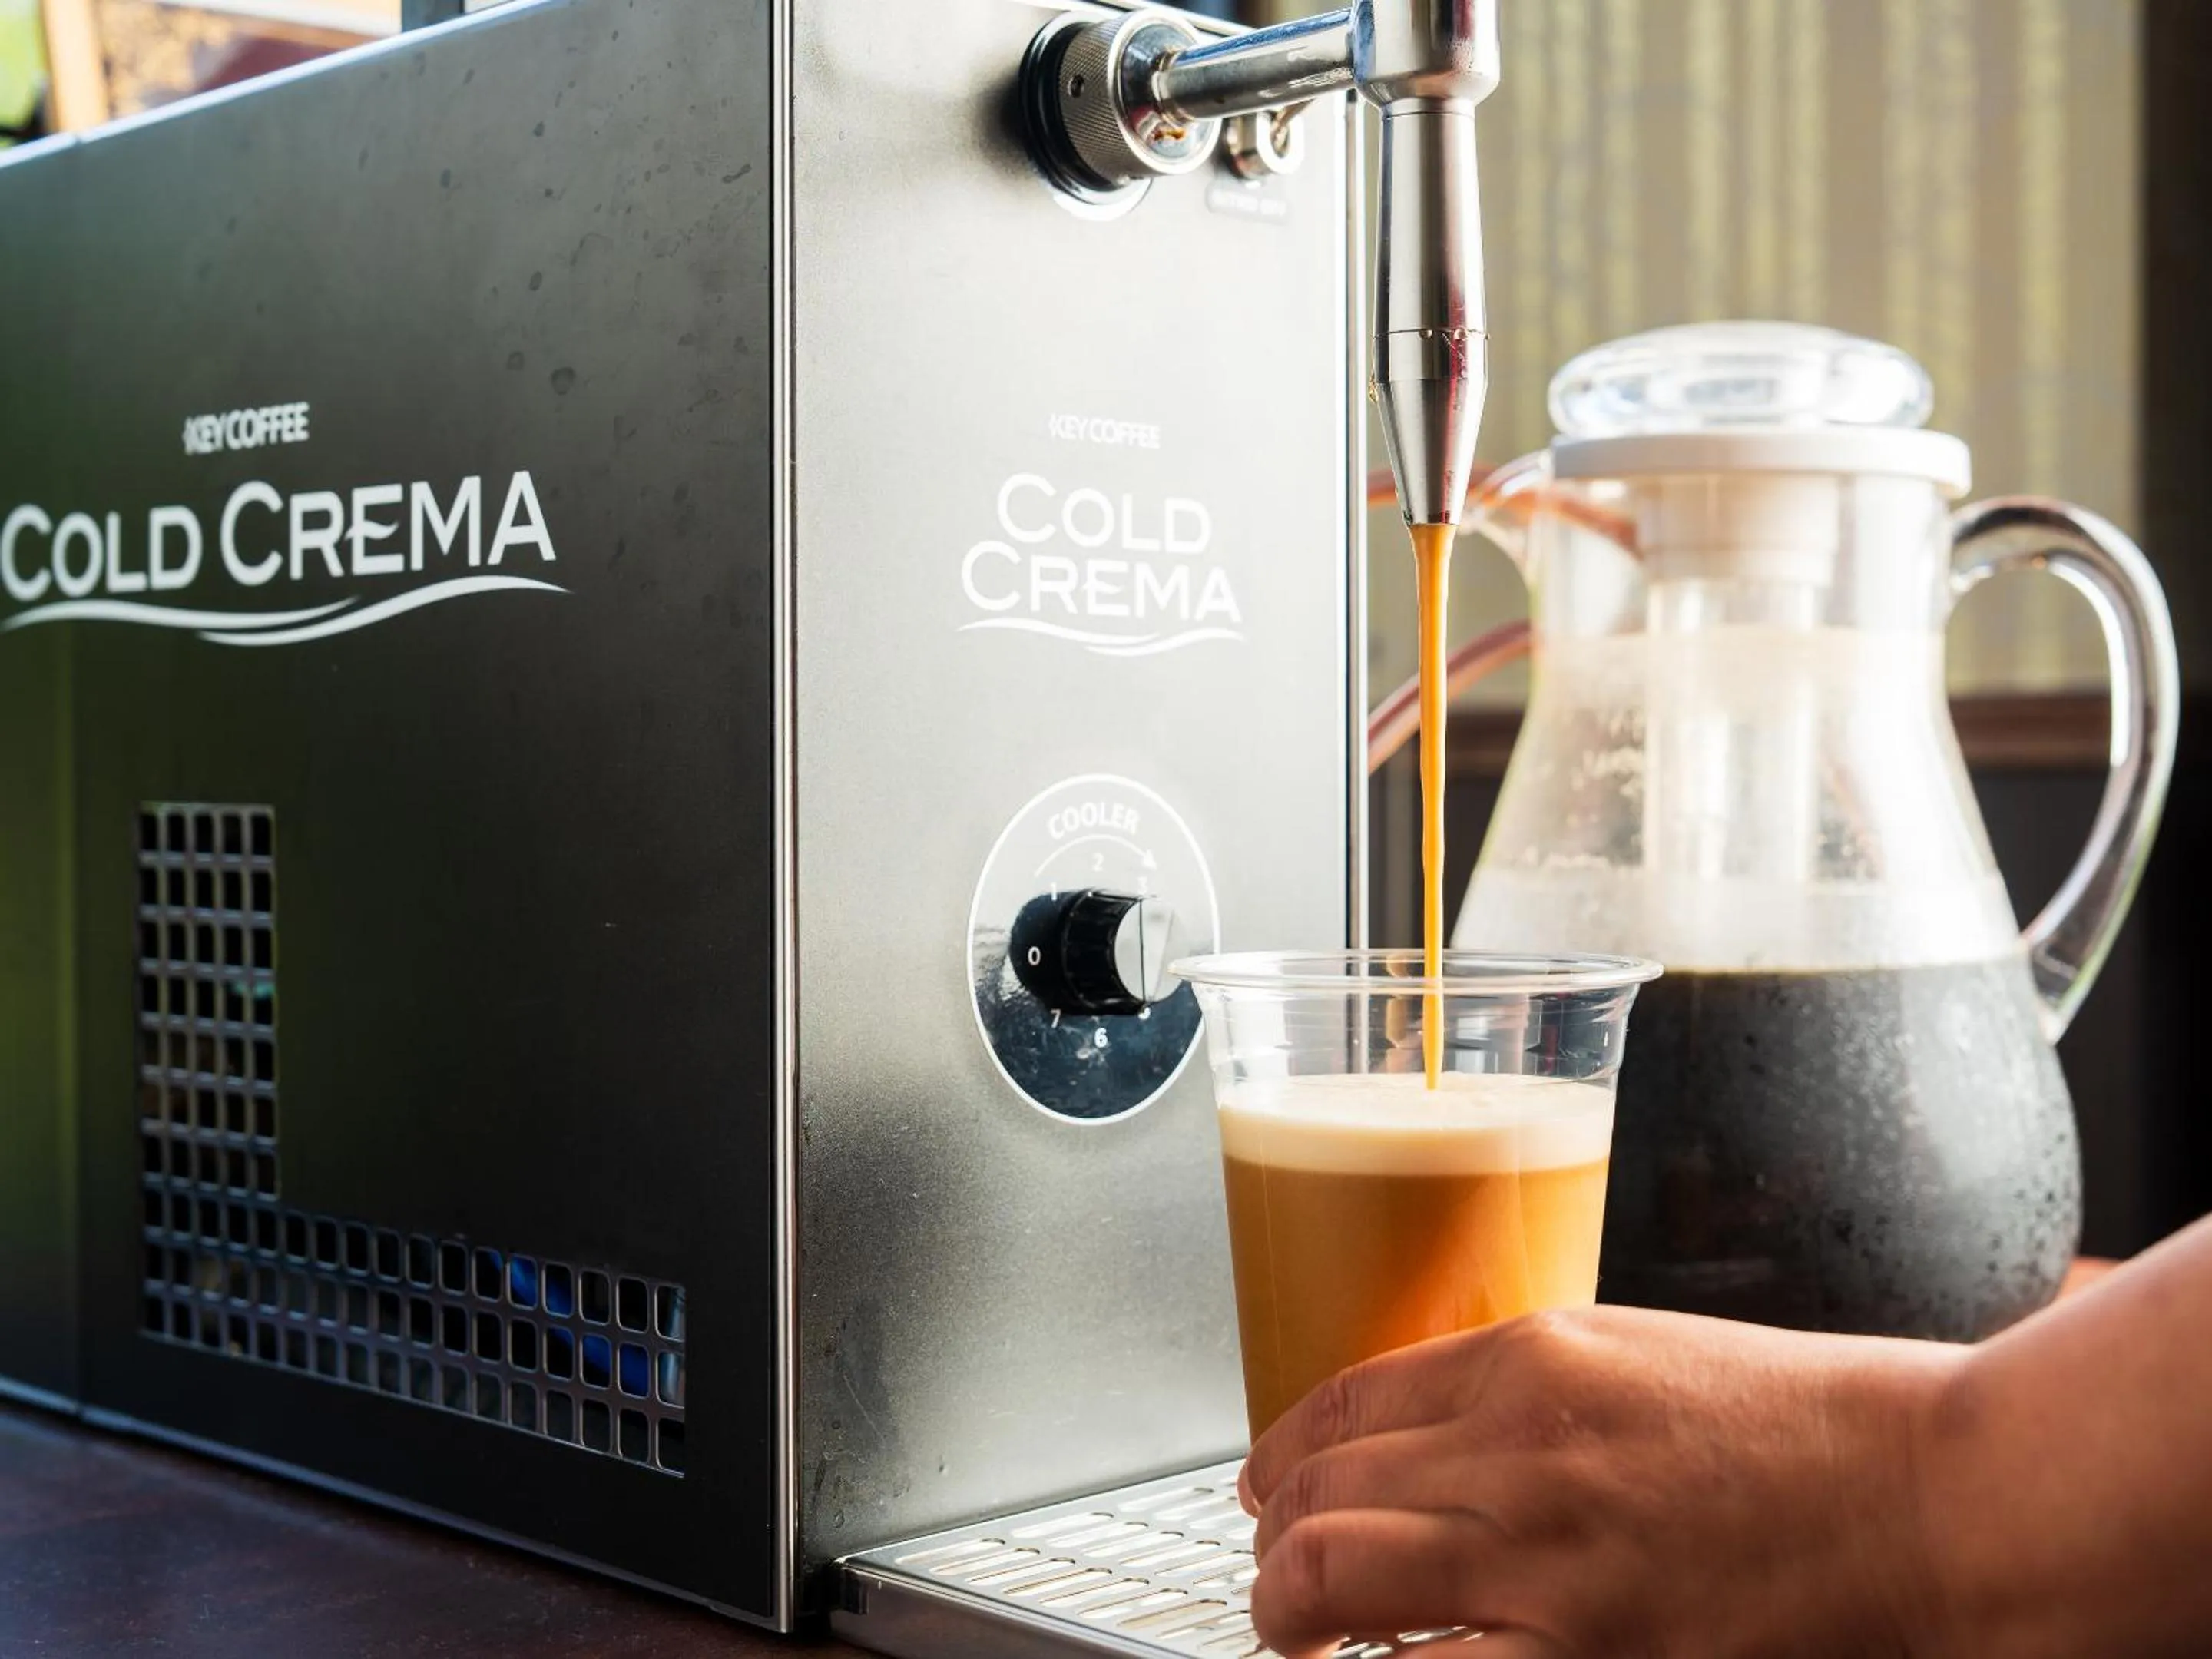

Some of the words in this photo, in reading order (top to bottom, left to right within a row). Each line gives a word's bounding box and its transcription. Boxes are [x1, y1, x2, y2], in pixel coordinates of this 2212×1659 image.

[997, 472, 1212, 555] COLD
[1, 504, 203, 601] COLD
[220, 470, 557, 587] CREMA
[962, 540, 1243, 623] CREMA
[1048, 801, 1141, 839] COOLER
[1091, 852, 1104, 873] 2
[1049, 882, 1058, 900] 1
[1027, 945, 1041, 966] 0
[1050, 1008, 1061, 1028] 7
[1094, 1027, 1108, 1048] 6
